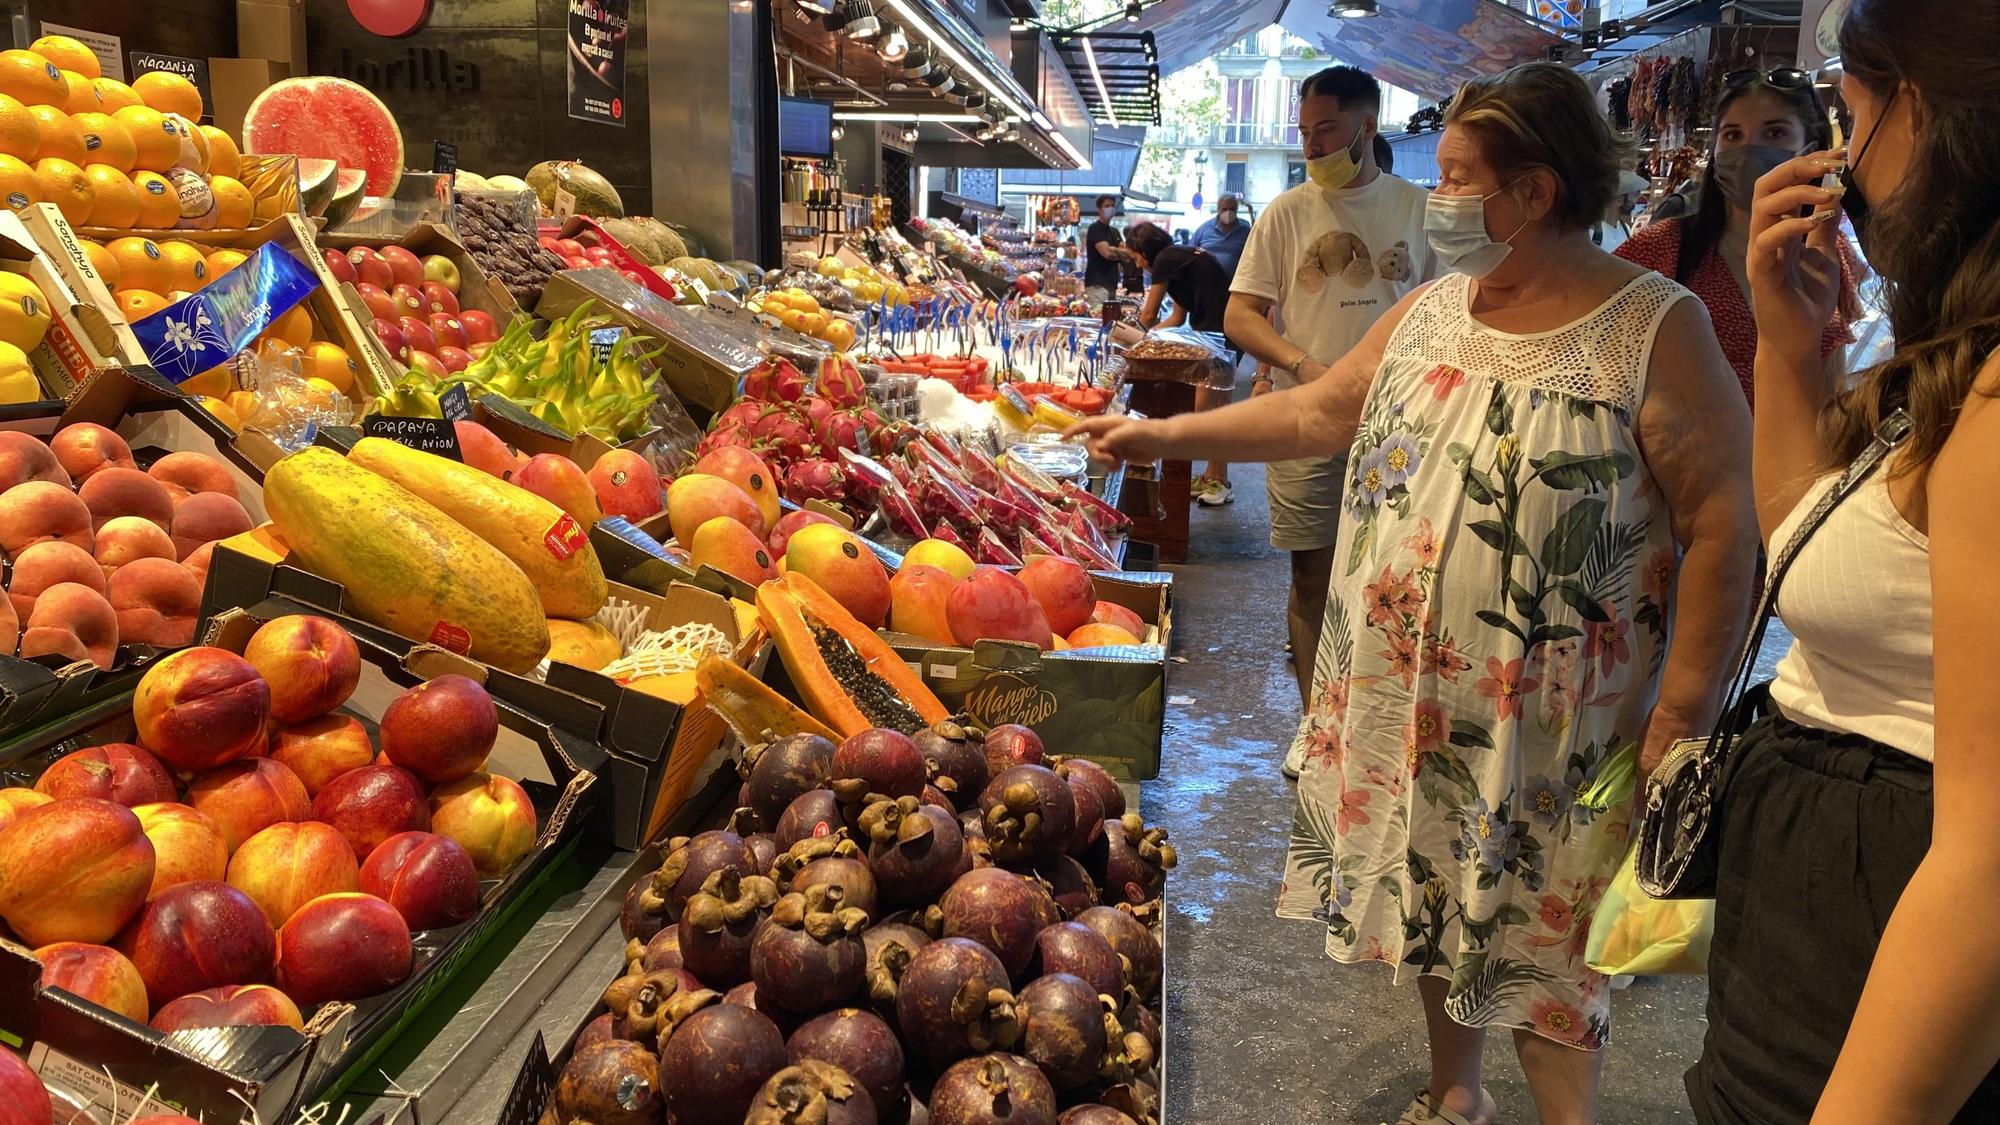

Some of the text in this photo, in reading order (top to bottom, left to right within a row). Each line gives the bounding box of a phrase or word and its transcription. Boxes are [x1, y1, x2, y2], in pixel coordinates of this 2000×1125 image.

[569, 0, 628, 29] Morilla fruites
[137, 54, 195, 73] NARANJA
[55, 218, 94, 279] Sanahuja
[298, 225, 327, 272] Sanahuja
[362, 343, 391, 391] Sanahuja
[372, 421, 437, 435] PAPAYA
[966, 683, 1039, 722] Mangos
[994, 695, 1053, 727] del cielo
[65, 1061, 83, 1076] SAT
